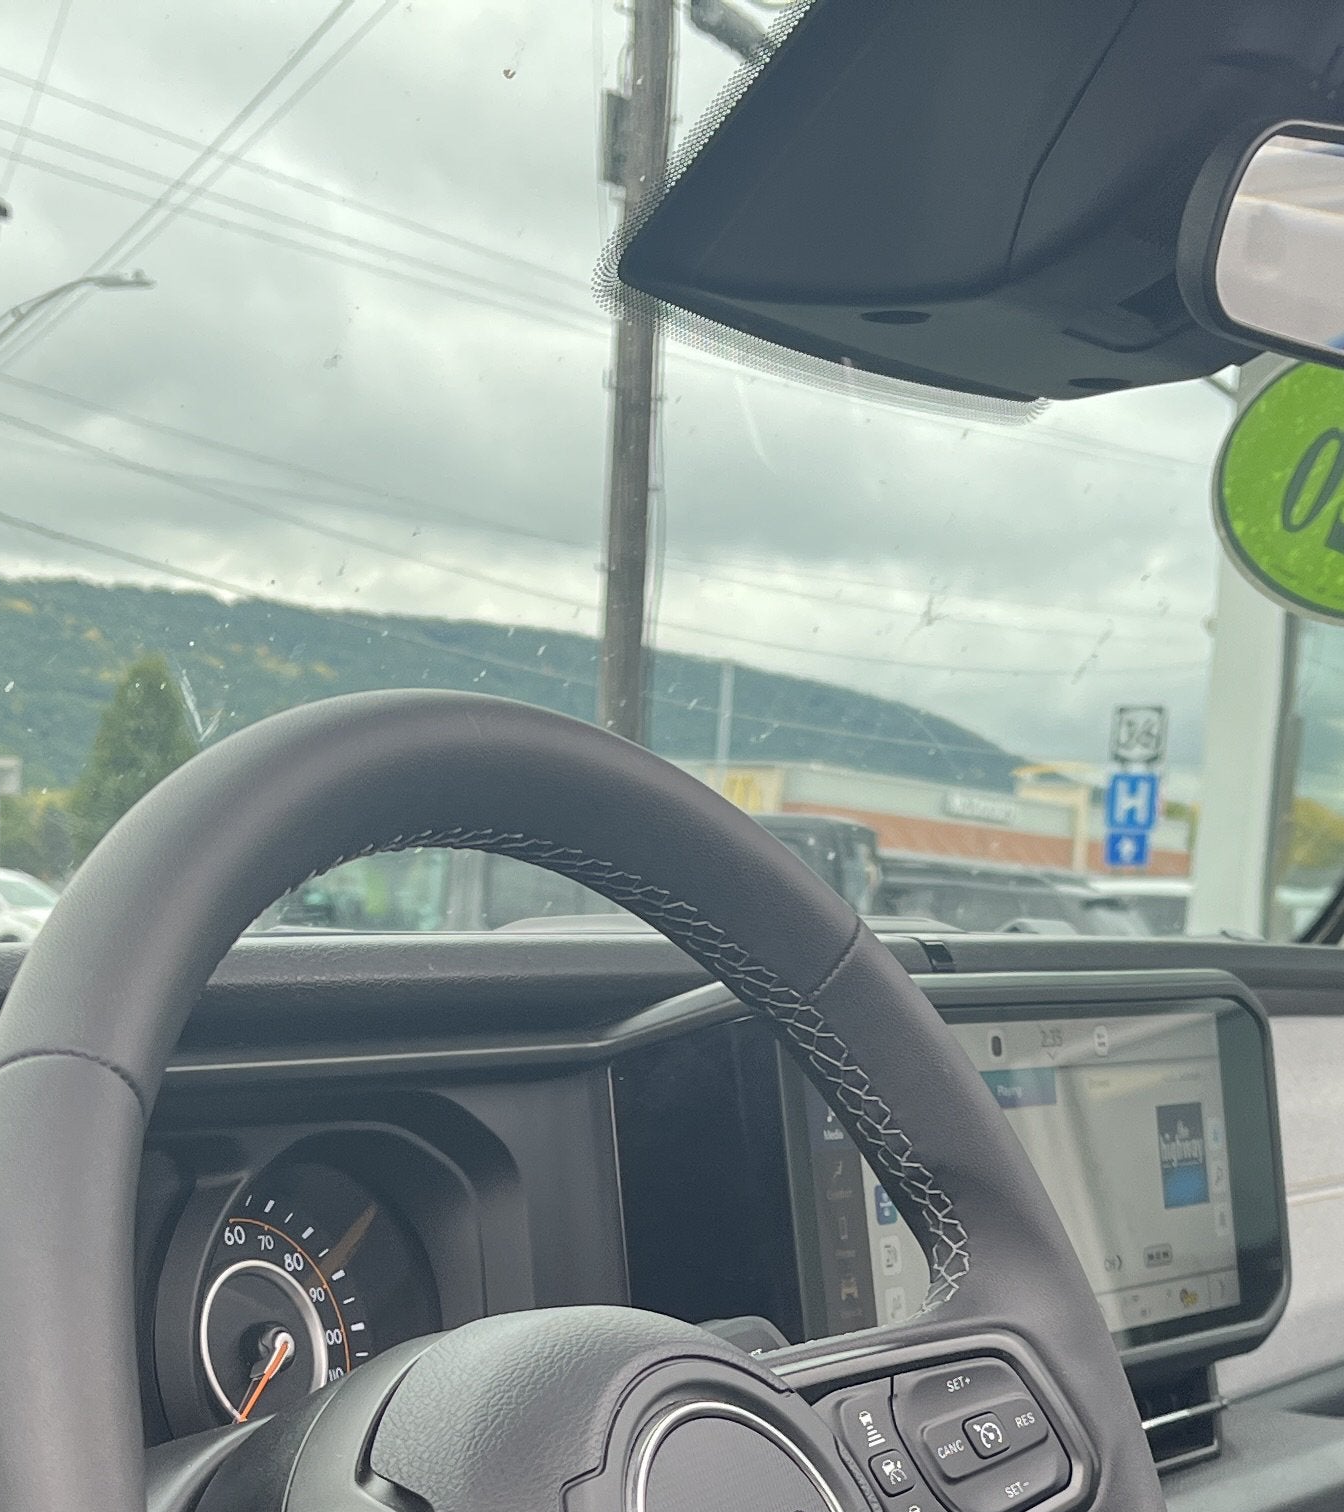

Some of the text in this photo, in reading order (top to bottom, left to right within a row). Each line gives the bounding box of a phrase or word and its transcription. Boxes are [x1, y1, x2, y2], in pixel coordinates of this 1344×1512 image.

[1115, 780, 1152, 823] H
[224, 1225, 246, 1246] 60
[257, 1235, 274, 1250] 70
[284, 1252, 304, 1271] 80
[308, 1287, 325, 1303] 90
[325, 1329, 343, 1345] 00
[937, 1412, 1035, 1459] CANC RES
